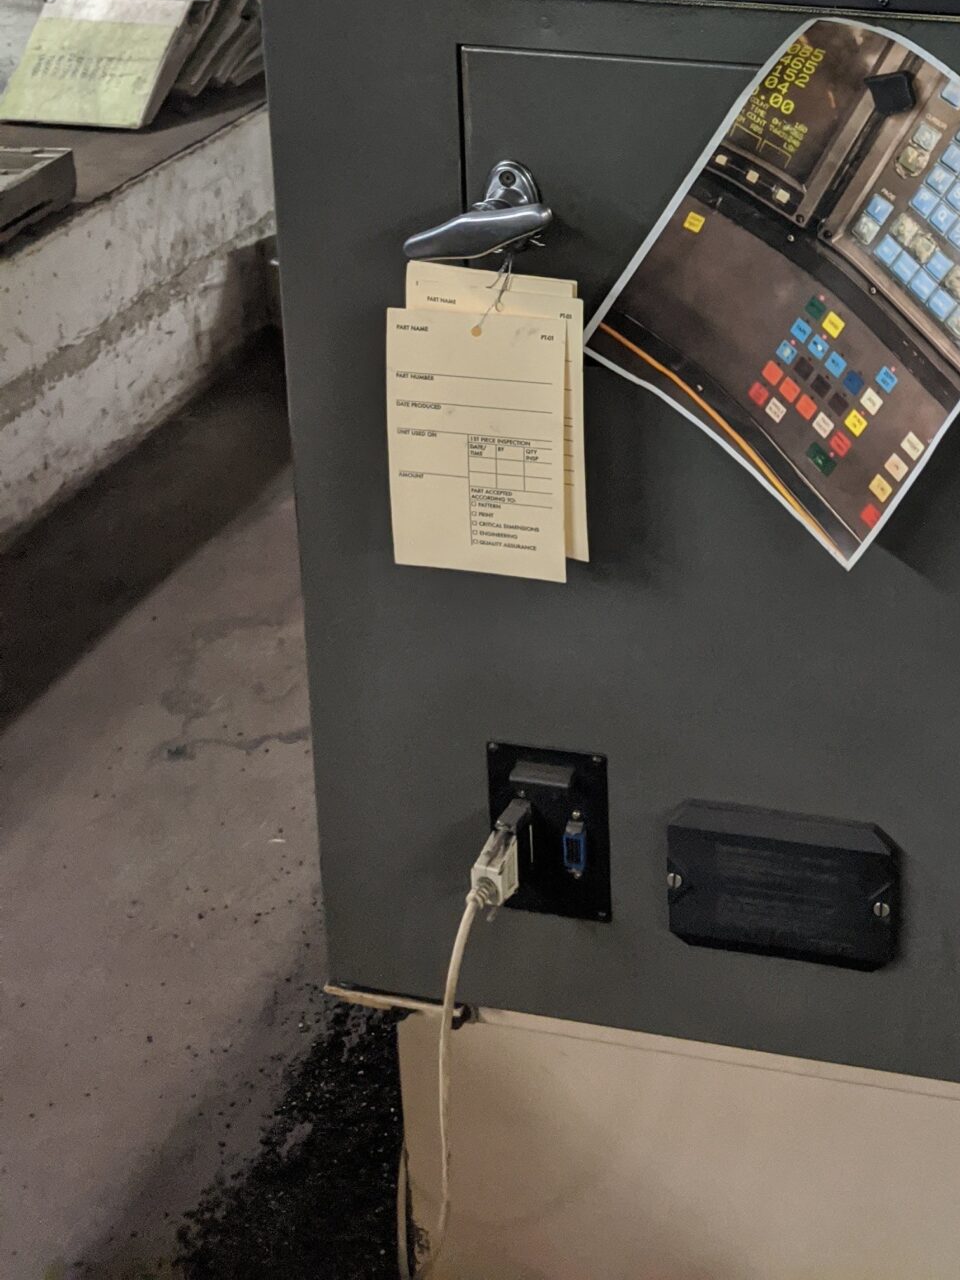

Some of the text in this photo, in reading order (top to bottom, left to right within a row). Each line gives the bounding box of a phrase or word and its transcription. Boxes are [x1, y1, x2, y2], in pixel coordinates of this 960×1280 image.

[787, 43, 827, 62] 085
[780, 55, 818, 74] 465
[772, 65, 810, 88] 152
[764, 75, 790, 95] 04
[427, 295, 440, 303] PART
[396, 371, 434, 381] PART NUMBER
[396, 400, 442, 410] DATE PRODUCED
[411, 429, 426, 437] USED
[496, 439, 531, 447] INSPECTION
[471, 494, 506, 502] ACCORDING
[485, 489, 513, 497] ACCEPTED
[479, 521, 540, 533] CRITICAL DIMENSIONS
[479, 530, 518, 540] ENGINEERING
[503, 543, 537, 551] ASSURANCE
